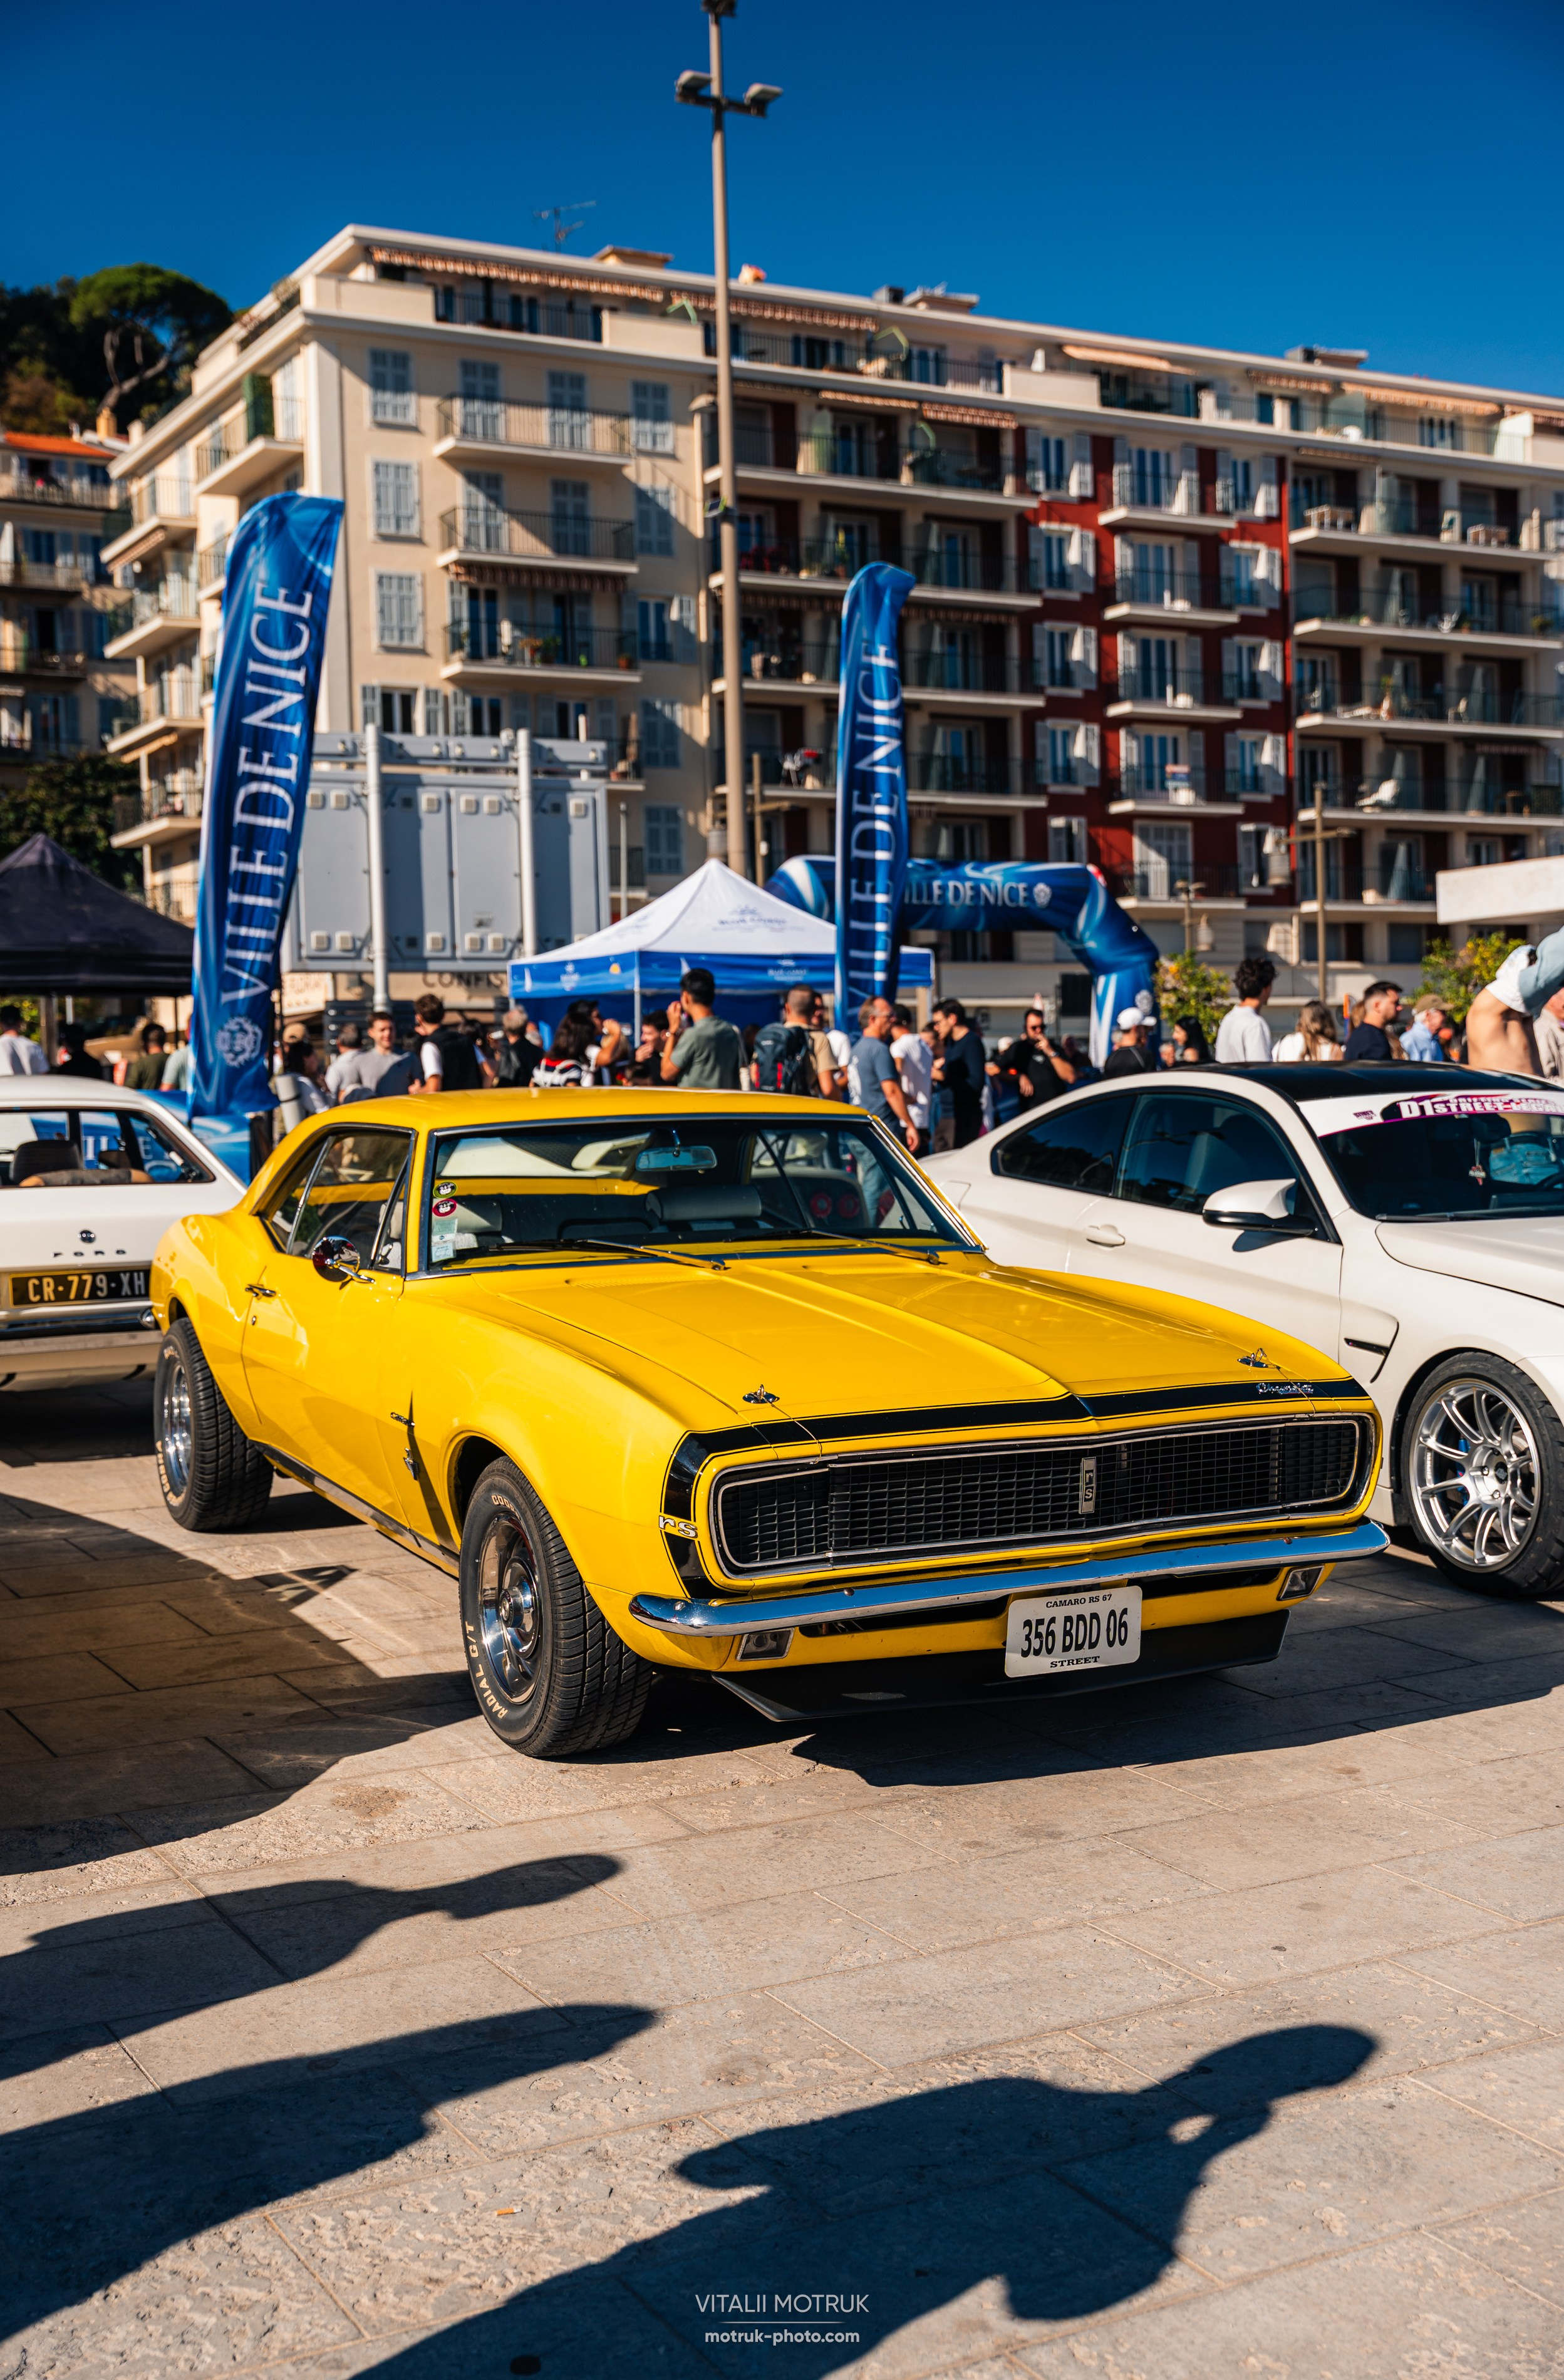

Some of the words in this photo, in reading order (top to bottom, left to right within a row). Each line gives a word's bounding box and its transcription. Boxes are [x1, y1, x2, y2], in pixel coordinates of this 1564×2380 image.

[241, 581, 313, 738] NICE
[232, 746, 298, 834] DE
[849, 790, 899, 862] DE
[948, 880, 974, 908] DE
[980, 880, 1028, 908] NICE
[221, 845, 289, 1005] VILLE
[28, 1271, 146, 1303] CR-779-XH
[1045, 1598, 1086, 1608] CAMARO
[1089, 1595, 1100, 1603] RS
[465, 1621, 480, 1658] G/T
[1020, 1616, 1057, 1658] 356
[1062, 1612, 1101, 1653] BDD
[1106, 1607, 1128, 1648] 06
[1050, 1655, 1100, 1669] STREET
[475, 1663, 509, 1719] RADIAL
